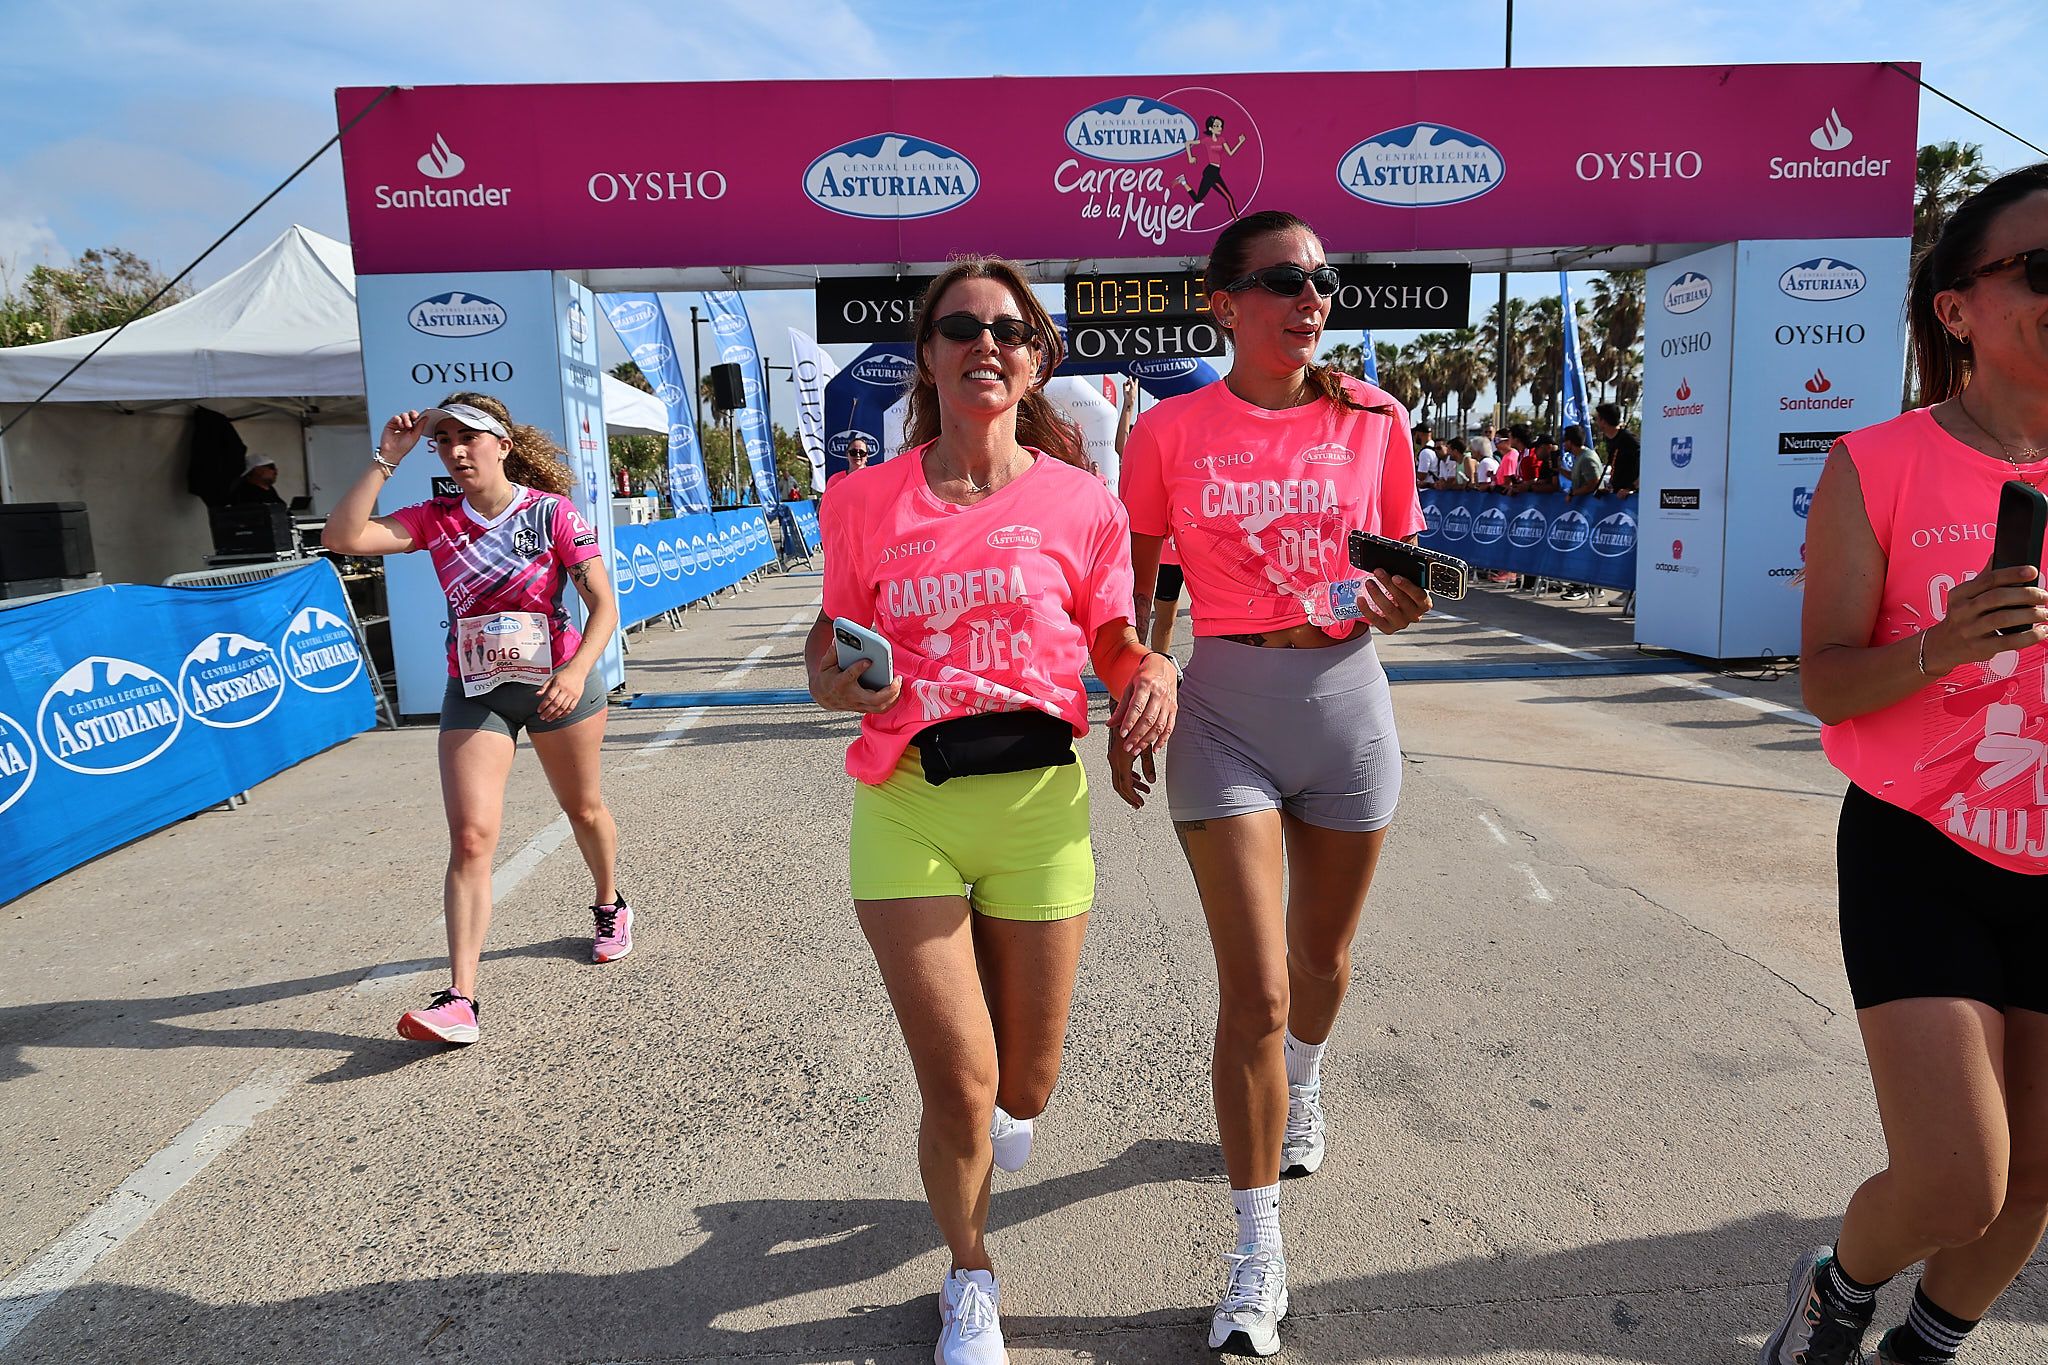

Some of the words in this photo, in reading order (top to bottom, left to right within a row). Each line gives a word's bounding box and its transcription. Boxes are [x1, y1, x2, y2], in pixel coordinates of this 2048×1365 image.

[1075, 121, 1188, 146] ASTURIANA
[1095, 119, 1137, 127] CENTRAL
[1141, 118, 1184, 126] LECHERA
[843, 163, 898, 172] CENTRAL
[904, 162, 960, 172] LECHERA
[1376, 153, 1428, 162] CENTRAL
[1434, 151, 1487, 160] LECHERA
[1575, 150, 1703, 181] OYSHO
[1769, 155, 1891, 180] Santander
[817, 166, 966, 198] ASTURIANA
[1053, 158, 1164, 194] Carrera
[1350, 156, 1492, 186] ASTURIANA
[374, 183, 511, 209] Santander
[587, 170, 727, 203] OYSHO
[1081, 195, 1102, 219] de
[1106, 192, 1121, 218] la
[1118, 188, 1204, 246] Mujer
[1785, 274, 1859, 291] ASTURIANA
[1339, 285, 1449, 310] OYSHO
[1667, 288, 1708, 308] ASTURIANA
[416, 309, 500, 327] ASTURIANA
[843, 300, 921, 324] OYSH
[1075, 324, 1218, 358] OYSHO
[1661, 331, 1711, 358] OYSHO
[1775, 323, 1865, 345] OYSHO
[412, 361, 513, 385] OYSHO
[856, 365, 910, 378] ASTURIAN
[1135, 360, 1194, 373] ASTURIANA
[1663, 402, 1704, 418] Santander
[1780, 396, 1855, 411] Santander
[1784, 437, 1836, 451] Neutroge
[1194, 452, 1254, 470] OYSHO
[1201, 479, 1340, 518] CARRERA
[888, 565, 1029, 618] CARRERA
[201, 664, 236, 680] CENTRAL
[289, 641, 359, 679] ASTURIANA
[68, 694, 116, 716] CENTRAL
[118, 682, 163, 703] LECHERA
[190, 665, 280, 715] ASTURIANA
[52, 697, 178, 759] ASTURIANA
